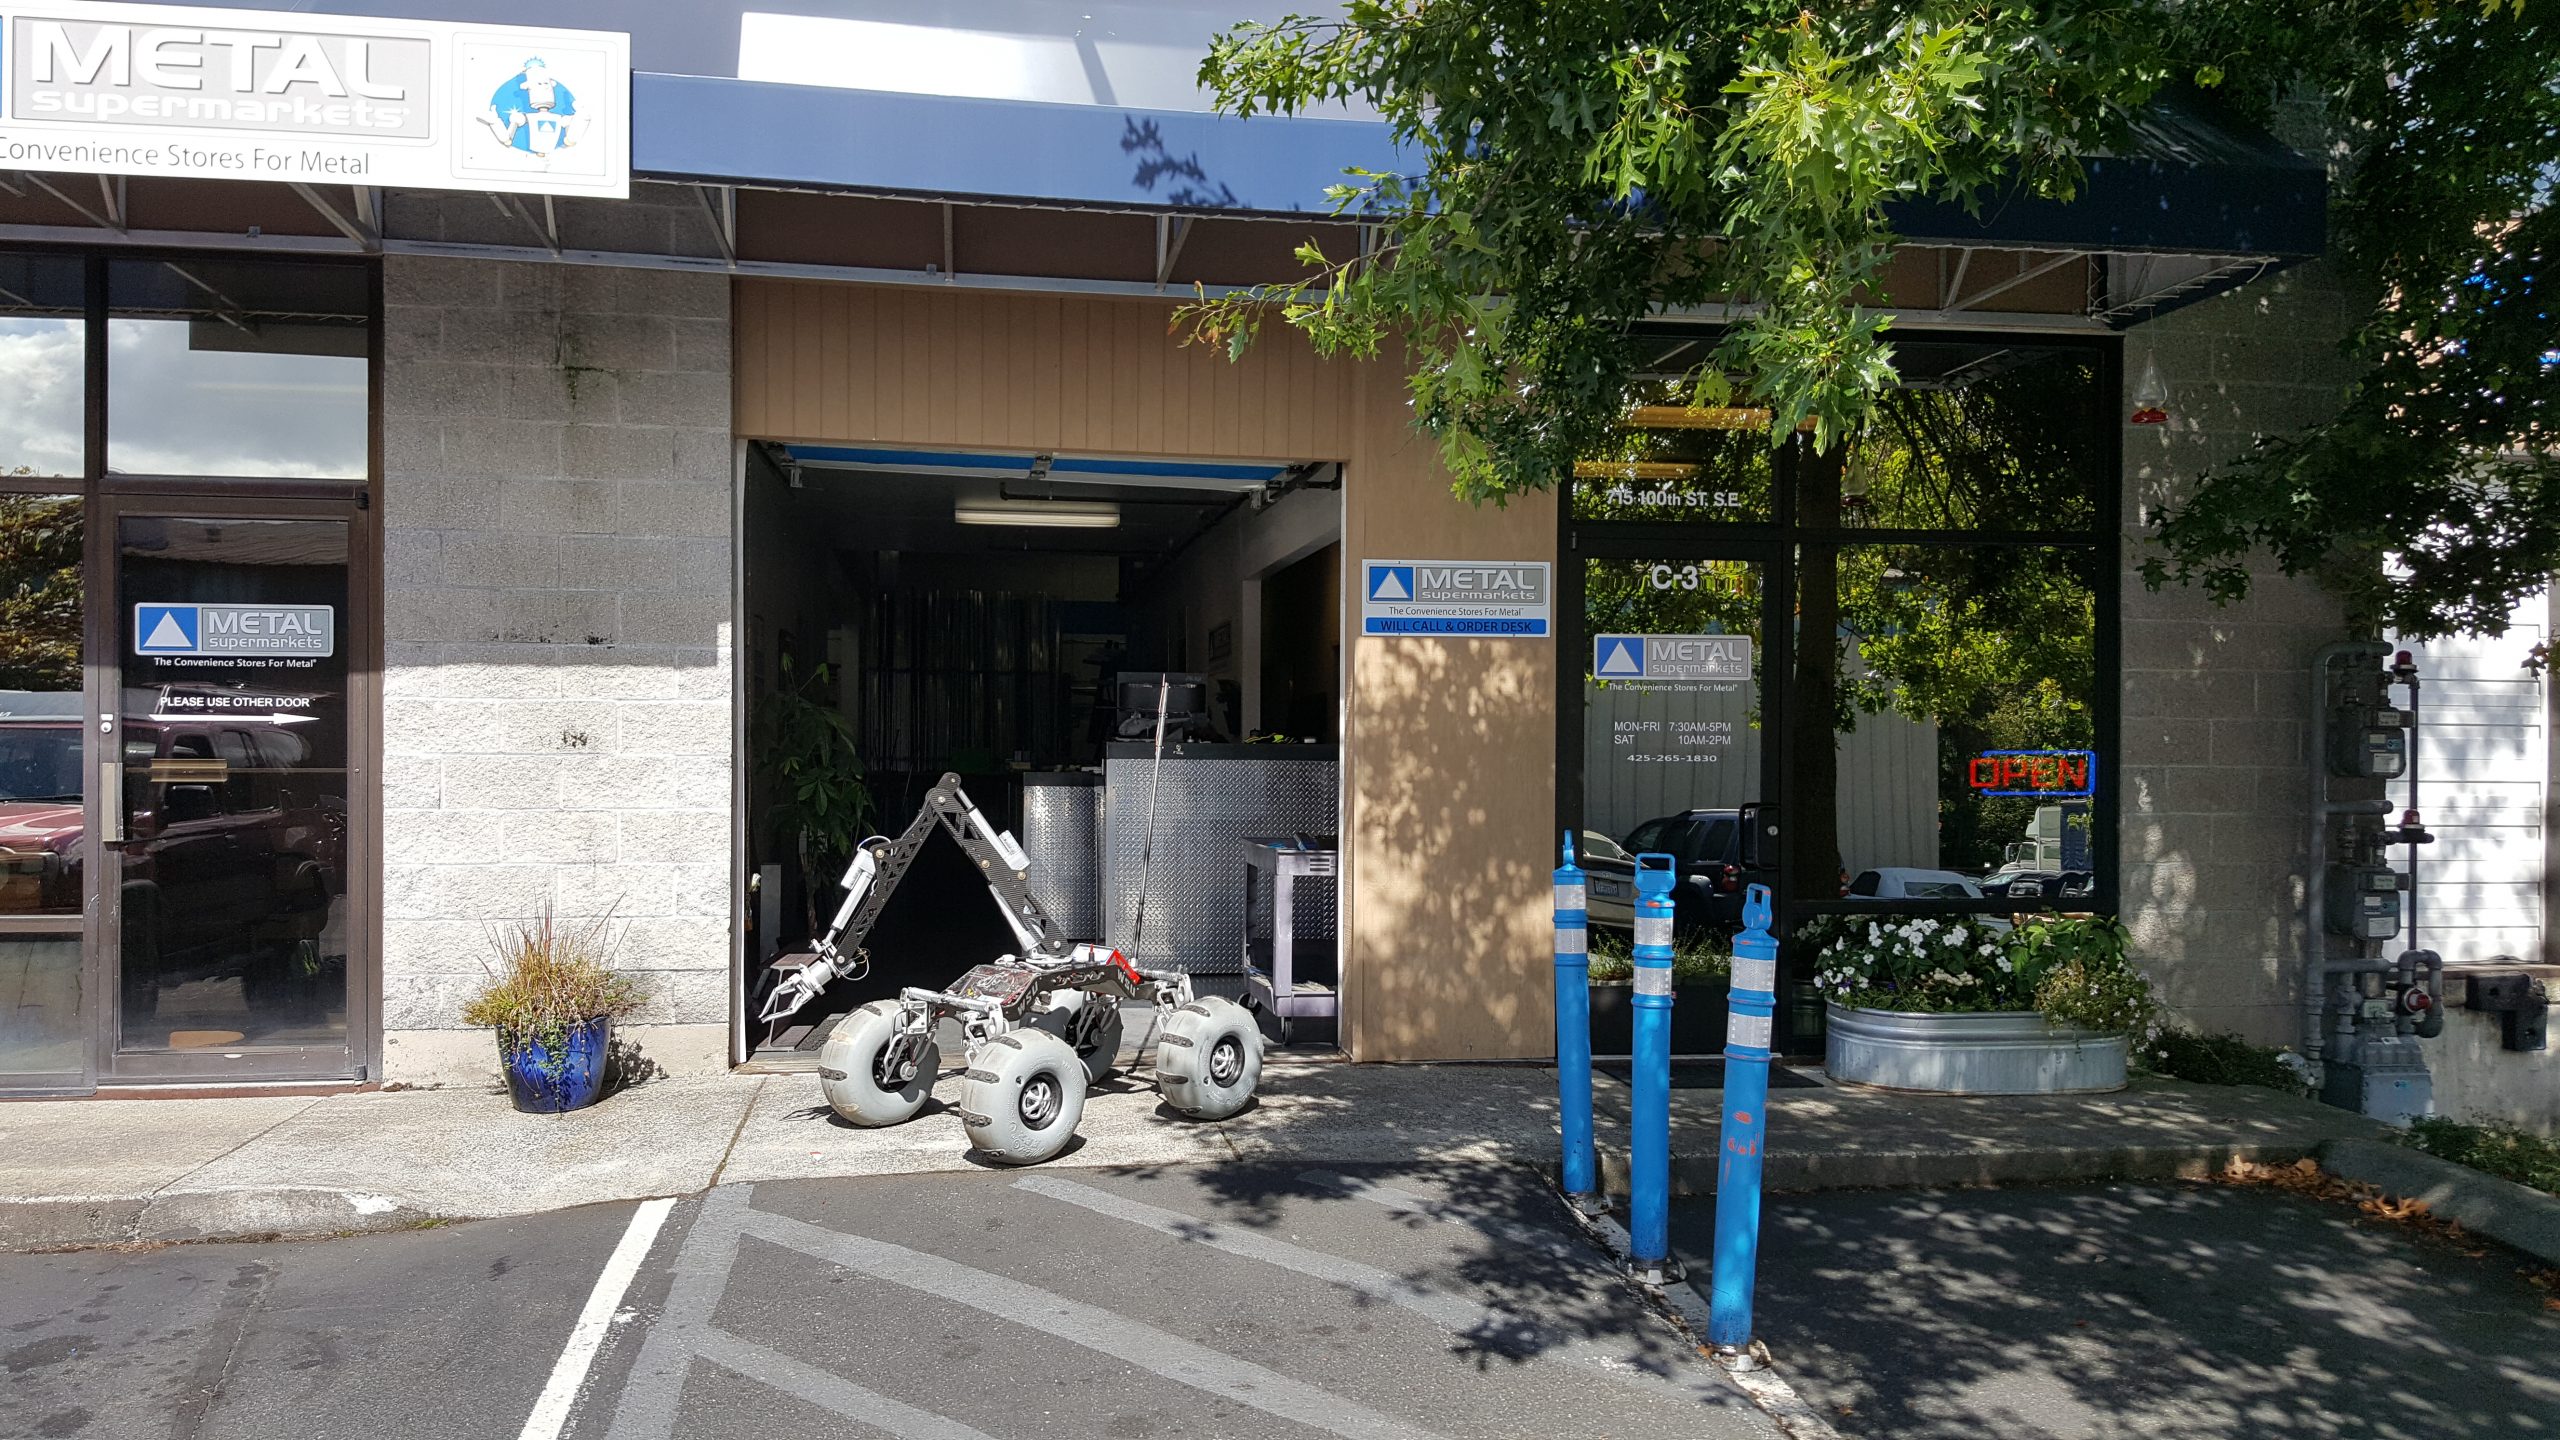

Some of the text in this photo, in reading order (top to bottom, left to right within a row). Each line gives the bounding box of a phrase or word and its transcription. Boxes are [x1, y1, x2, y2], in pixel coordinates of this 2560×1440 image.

[32, 21, 404, 101] METAL
[31, 90, 405, 128] supermarkets
[168, 144, 244, 169] Stores
[254, 149, 291, 170] For
[301, 151, 368, 175] Metal
[1607, 490, 1633, 505] 715
[1638, 490, 1681, 506] 100th
[1421, 568, 1535, 590] METAL
[1651, 565, 1699, 590] C-3
[1421, 590, 1535, 601] supermarkets
[1389, 607, 1404, 616] The
[1405, 607, 1457, 616] Convenience
[1459, 608, 1483, 616] Stores
[1485, 608, 1497, 616] For
[208, 611, 323, 635] METAL
[1380, 620, 1532, 632] WILL CALL & ORDER DESK
[208, 635, 323, 651] supermarkets
[1652, 641, 1742, 662] METAL
[154, 657, 172, 667] The
[174, 657, 235, 668] Convenience
[236, 658, 266, 668] Stores
[268, 659, 283, 668] For
[1652, 662, 1742, 675] supermarkets
[1609, 683, 1623, 691] The
[1624, 683, 1672, 692] Convenience
[1674, 684, 1697, 692] Stores
[1699, 684, 1712, 692] For
[160, 697, 310, 708] PLEASE USE OTHER DOOR
[1614, 721, 1731, 732] MON-FRI 7:30AM-5PM
[1614, 735, 1731, 745] SAT 10AM-2PM
[1627, 754, 1717, 762] 425-265-1830
[1969, 757, 2086, 788] OPEN
[1017, 980, 1039, 1016] WSU
